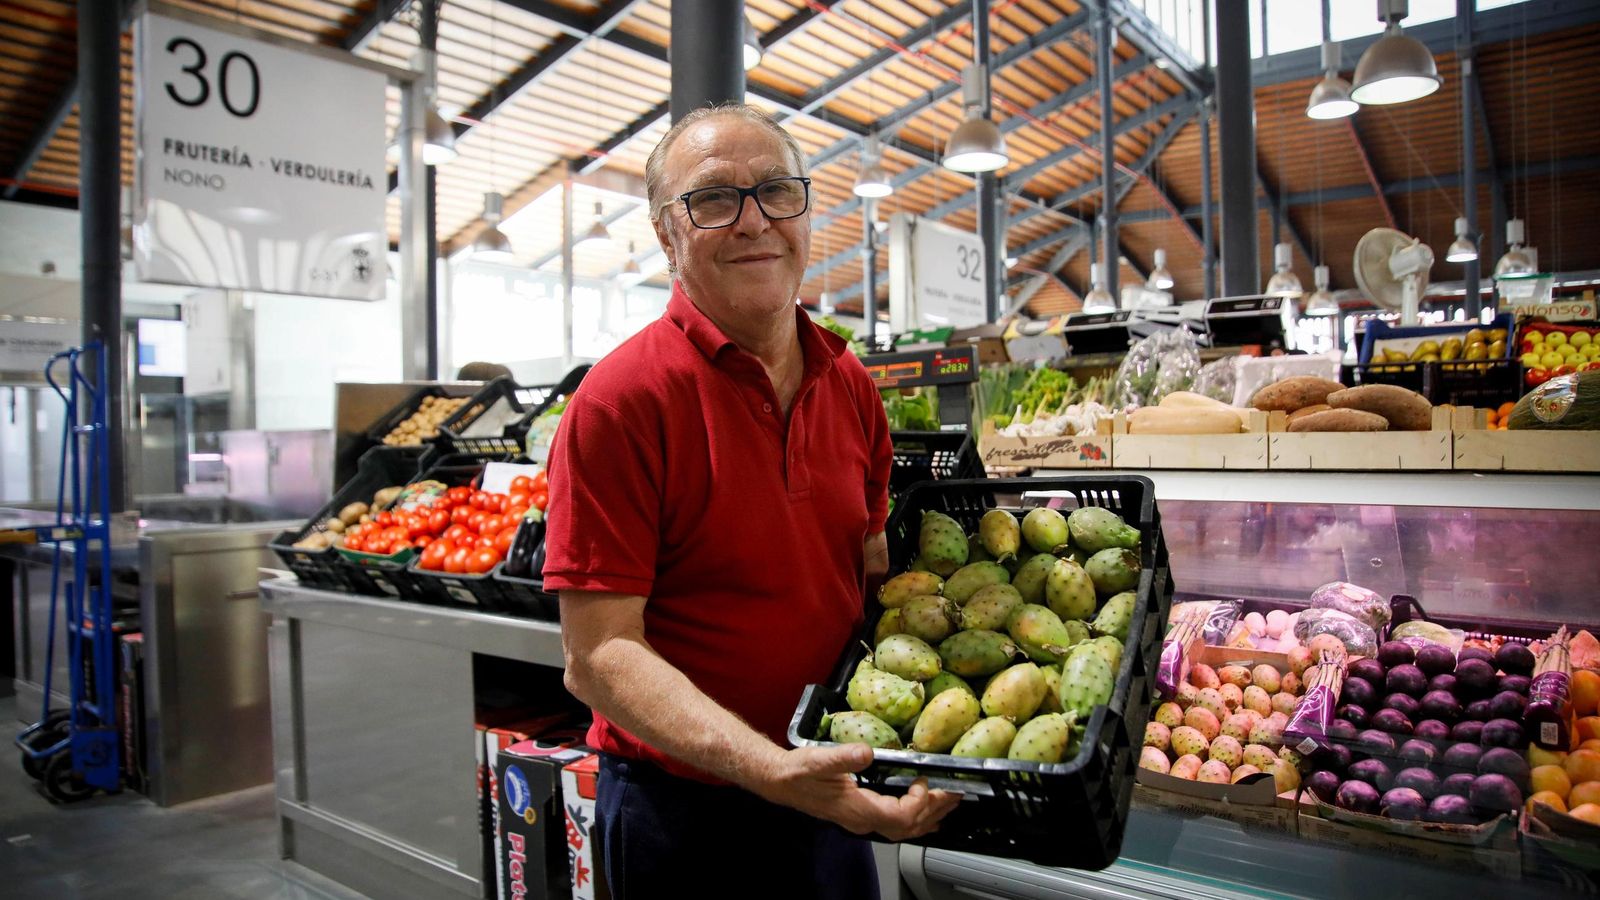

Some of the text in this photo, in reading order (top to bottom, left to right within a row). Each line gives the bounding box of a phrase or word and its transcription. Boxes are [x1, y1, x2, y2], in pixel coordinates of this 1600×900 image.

[164, 36, 261, 118] 30
[163, 137, 374, 190] FRUTERÍA VERDULERÍA
[163, 167, 226, 192] NONO
[957, 244, 982, 283] 32
